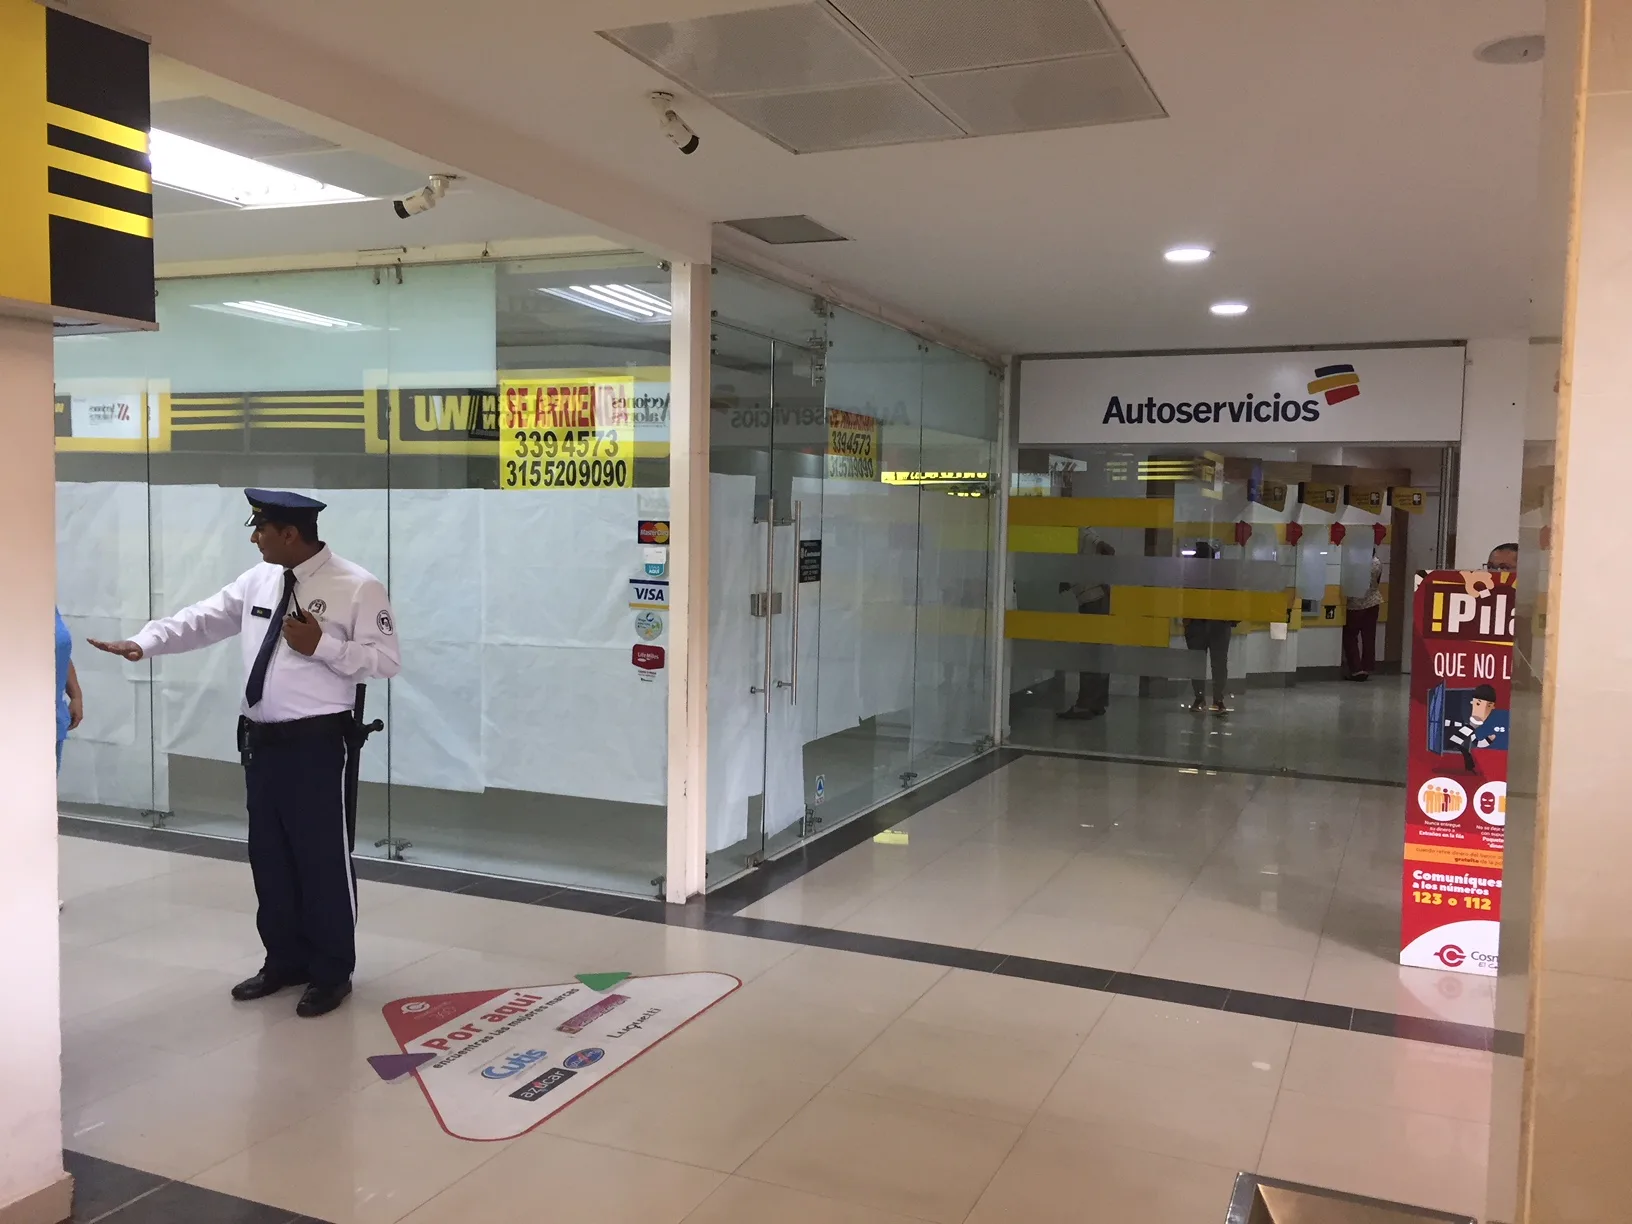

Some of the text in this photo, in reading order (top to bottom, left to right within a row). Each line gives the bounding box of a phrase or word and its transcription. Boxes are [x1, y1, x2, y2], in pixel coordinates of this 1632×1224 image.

[505, 384, 629, 428] SE ARRIENDA
[1102, 392, 1320, 424] Autoservicios
[515, 430, 620, 458] 3394573
[831, 430, 872, 456] 3394573
[506, 459, 627, 487] 3155209090
[634, 587, 665, 601] VISA
[1434, 652, 1511, 679] QUE NO L
[1412, 881, 1490, 896] a los números
[1412, 891, 1492, 911] 123 o 112
[421, 1022, 483, 1051] Por
[479, 992, 543, 1023] aquí
[432, 1034, 495, 1069] encuentras
[489, 1025, 511, 1040] las
[508, 1004, 549, 1028] mejores
[547, 987, 580, 1006] marcas
[481, 1048, 548, 1080] Cutis
